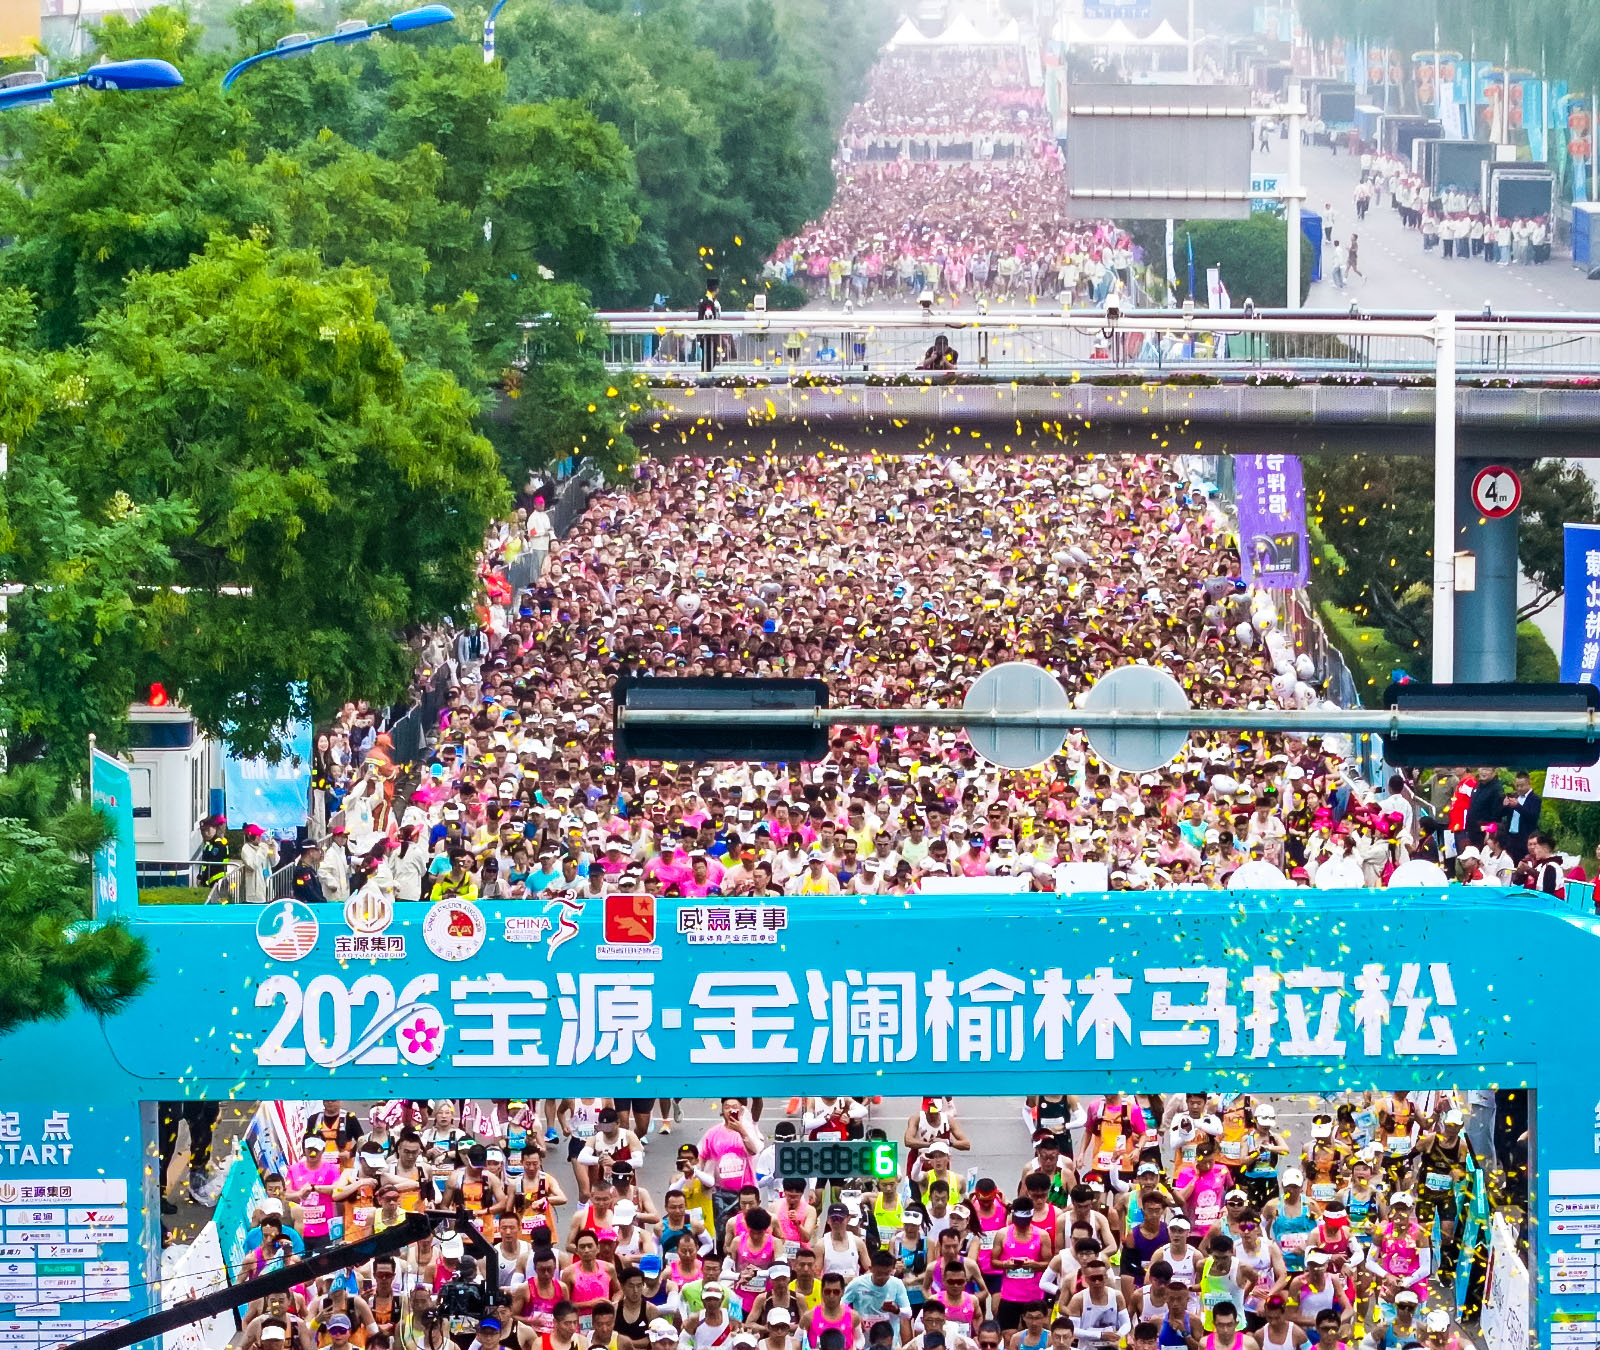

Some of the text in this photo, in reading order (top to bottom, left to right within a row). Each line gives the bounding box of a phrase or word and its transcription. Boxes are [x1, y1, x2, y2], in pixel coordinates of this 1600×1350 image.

[507, 919, 551, 930] CHINA
[679, 908, 786, 931] 威赢赛事
[336, 937, 405, 952] 宝源集团
[21, 1186, 72, 1198] 宝源集团
